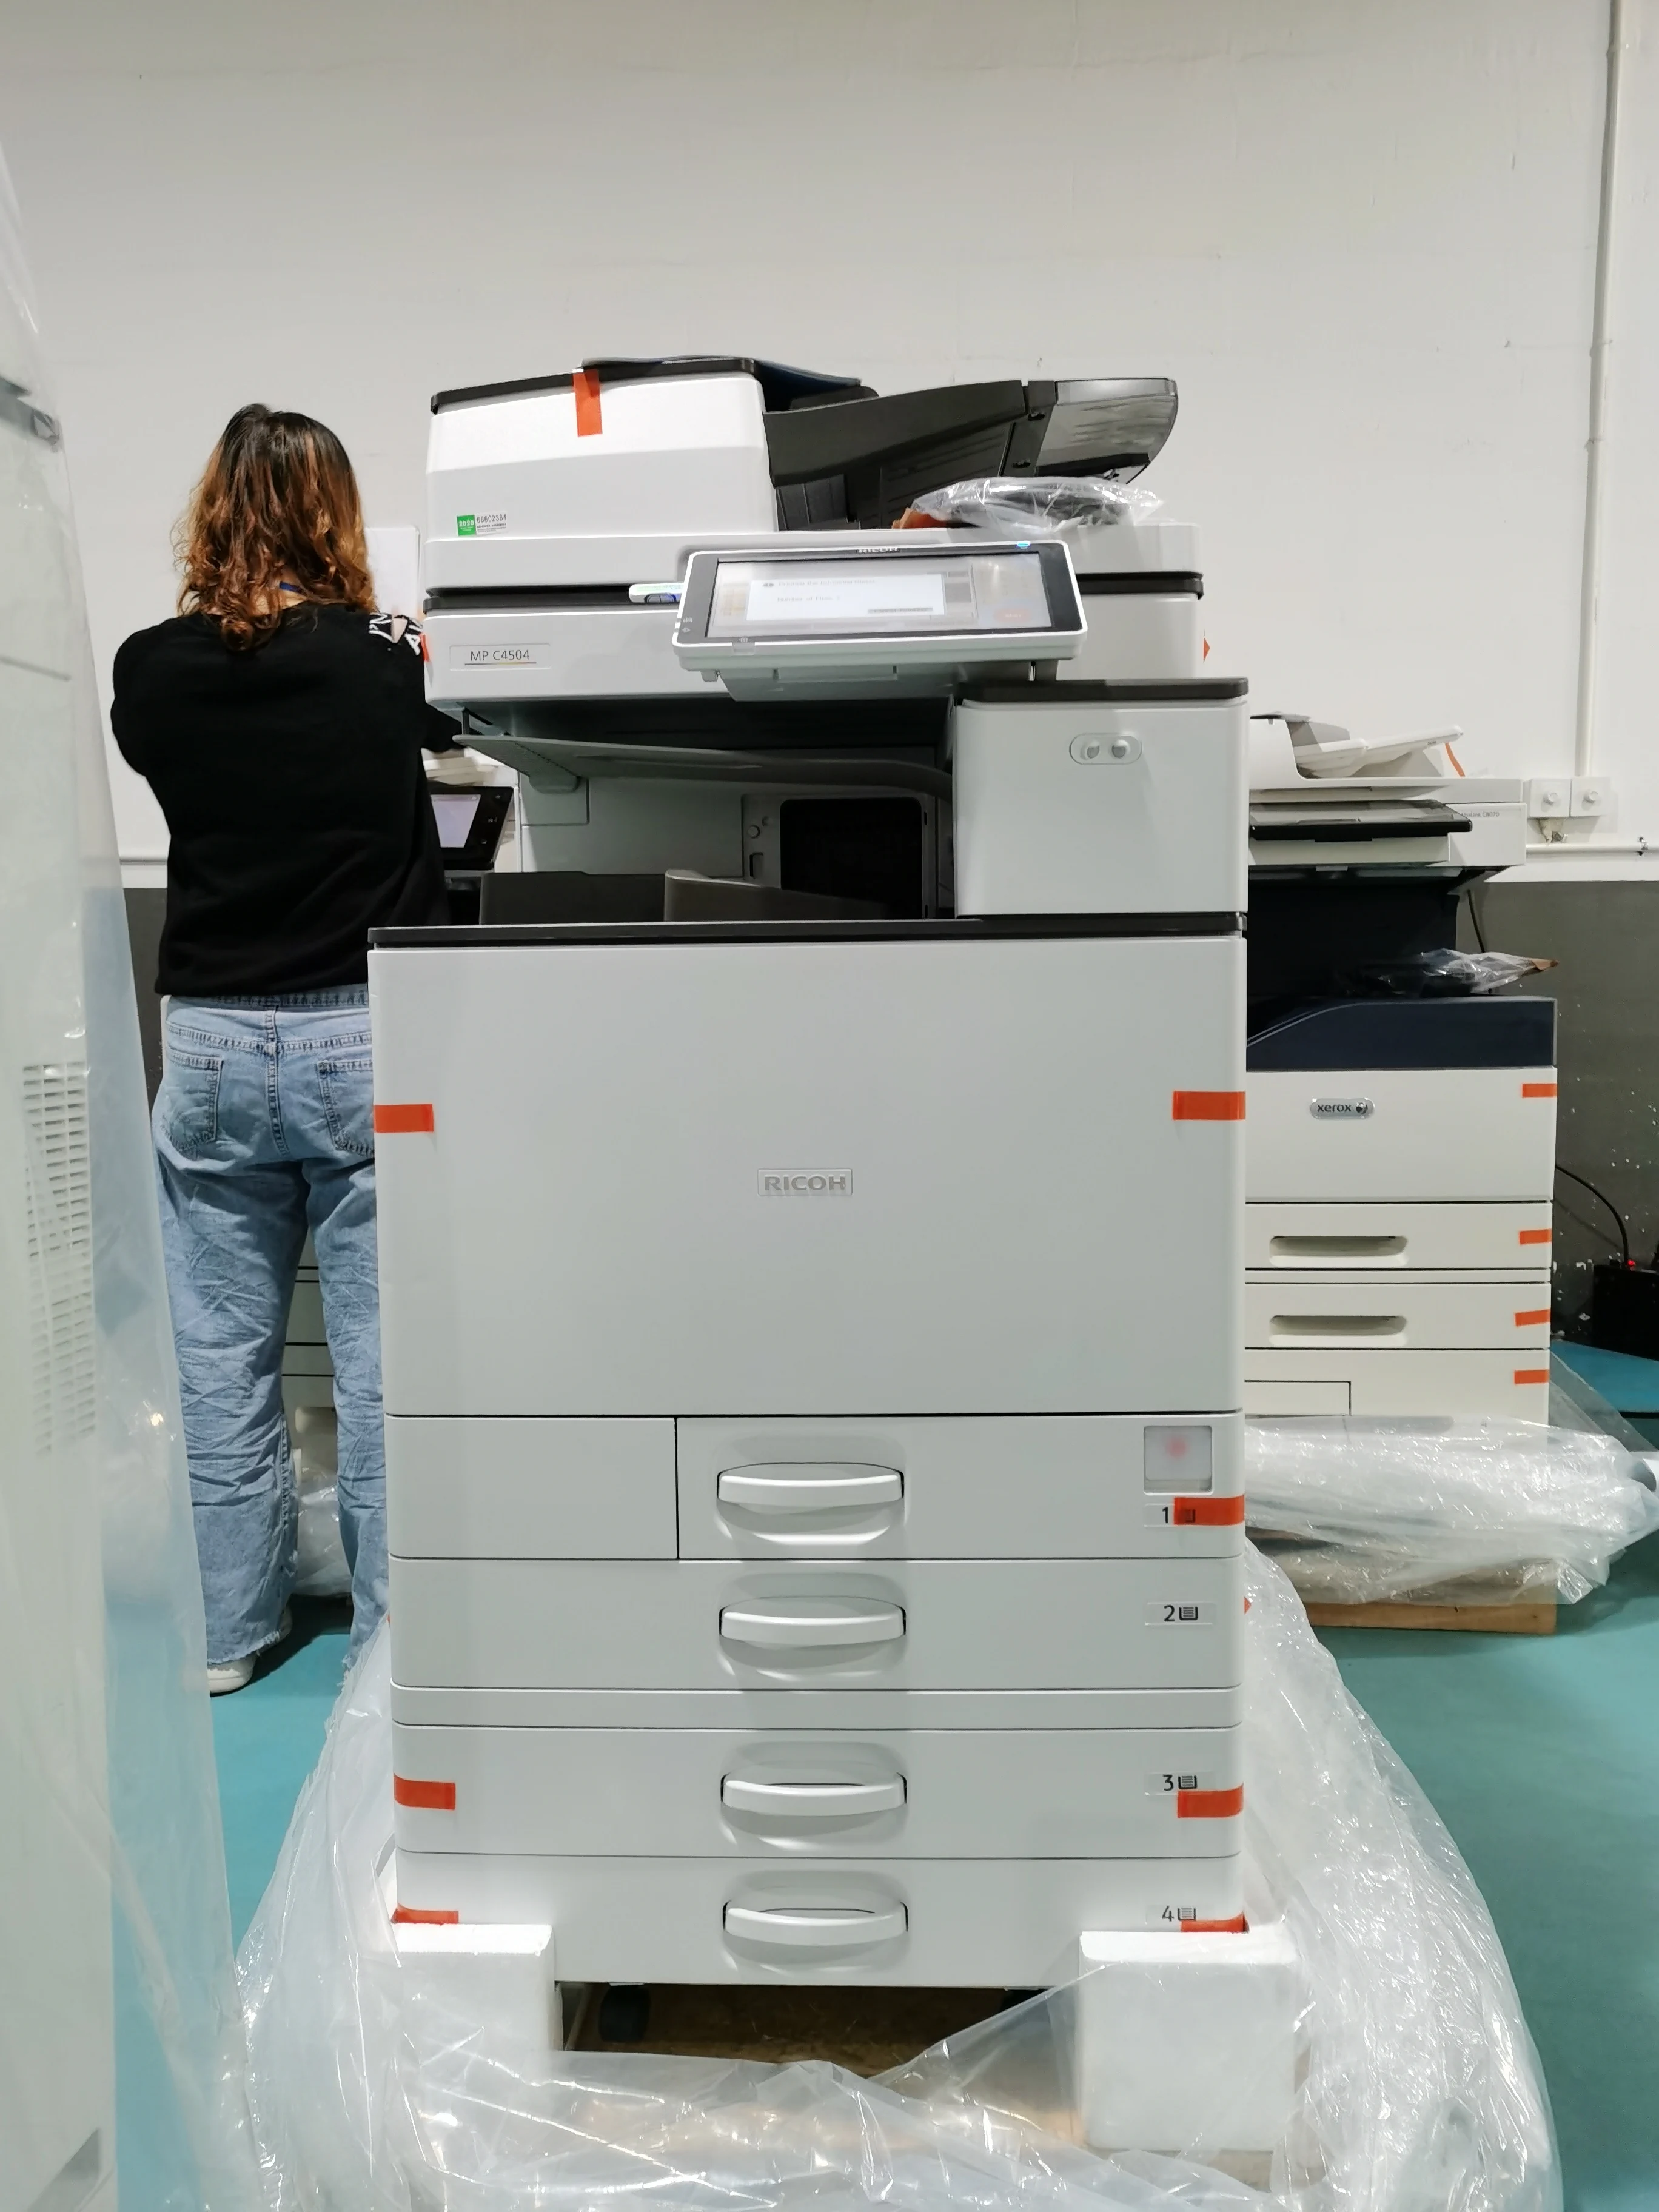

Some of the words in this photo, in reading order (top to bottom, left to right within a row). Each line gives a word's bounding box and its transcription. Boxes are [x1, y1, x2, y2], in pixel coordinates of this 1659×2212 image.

[470, 651, 489, 661] MP
[492, 649, 530, 661] C4504
[1317, 1104, 1352, 1113] xerox
[764, 1175, 846, 1190] RICOH
[1162, 1507, 1168, 1523] 1
[1164, 1604, 1175, 1622] 2
[1162, 1774, 1174, 1791] 3
[1161, 1906, 1175, 1922] 4
